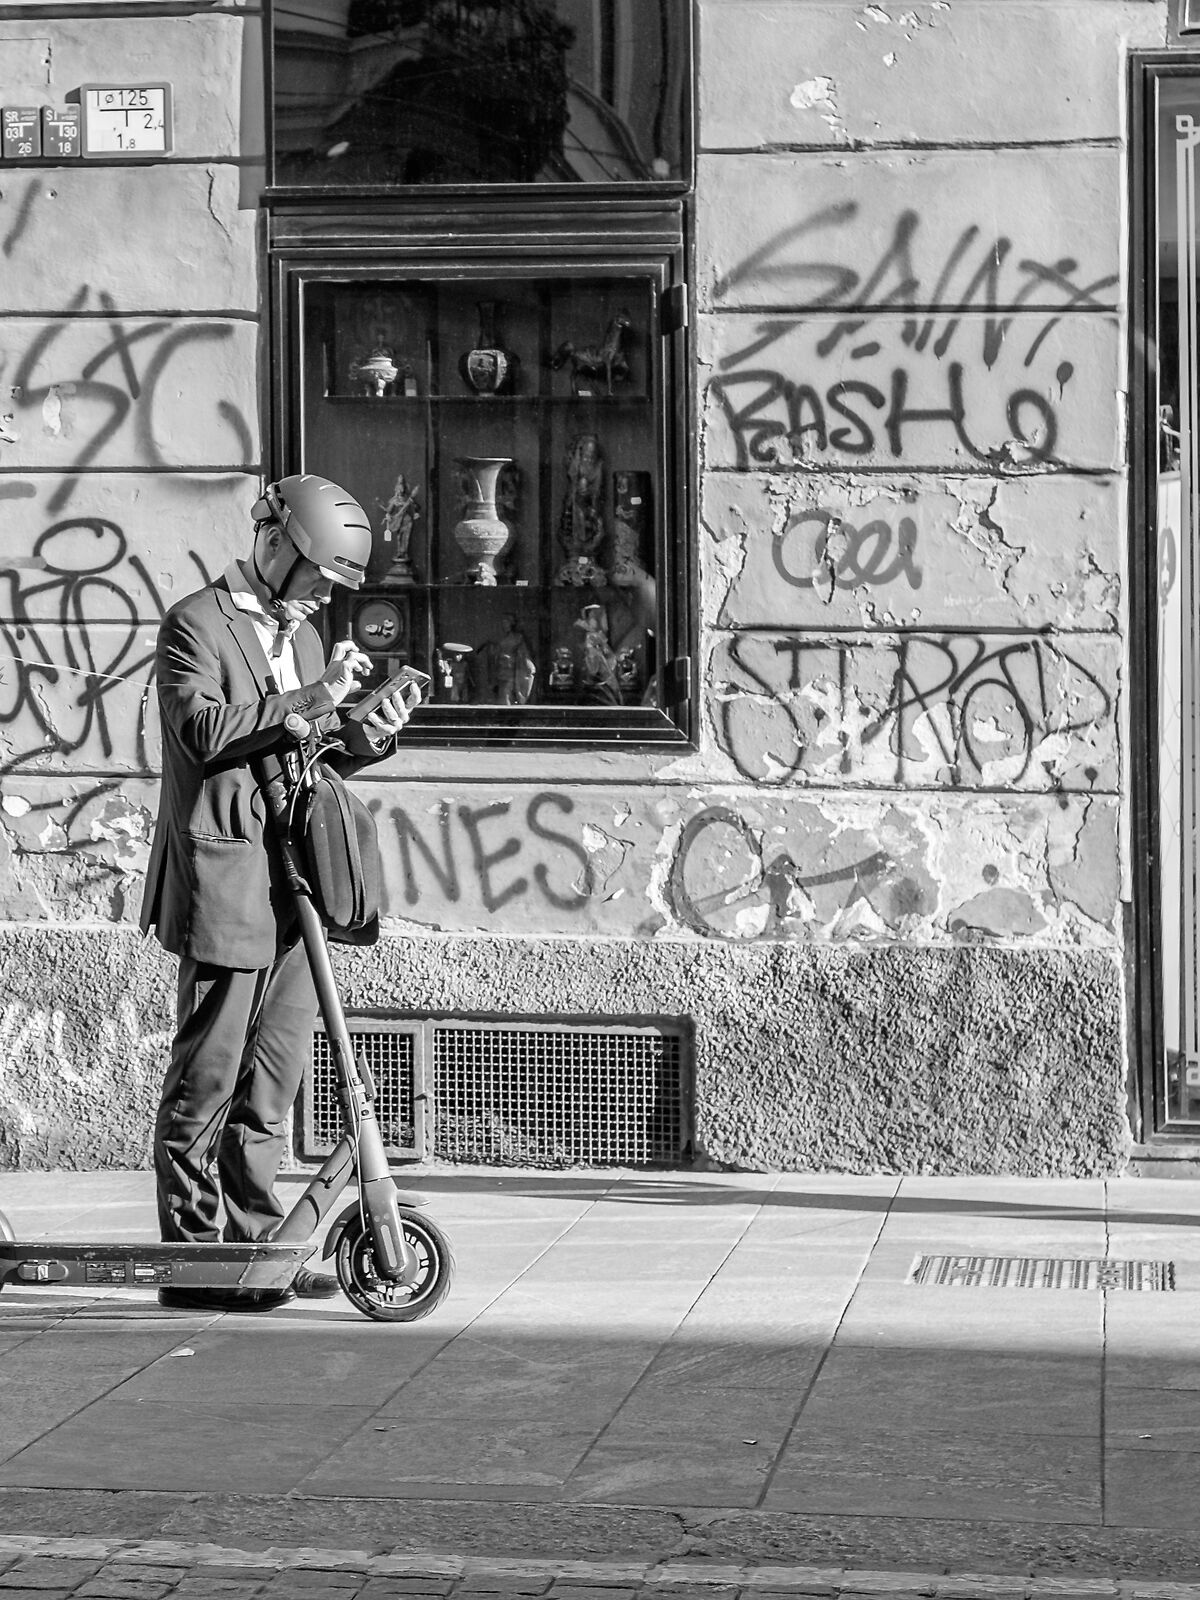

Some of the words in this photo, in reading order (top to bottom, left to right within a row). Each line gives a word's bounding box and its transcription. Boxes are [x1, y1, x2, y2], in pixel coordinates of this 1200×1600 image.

[5, 111, 19, 122] SR
[5, 127, 19, 139] 03
[63, 126, 77, 138] 30
[18, 142, 32, 154] 26
[58, 142, 72, 153] 18
